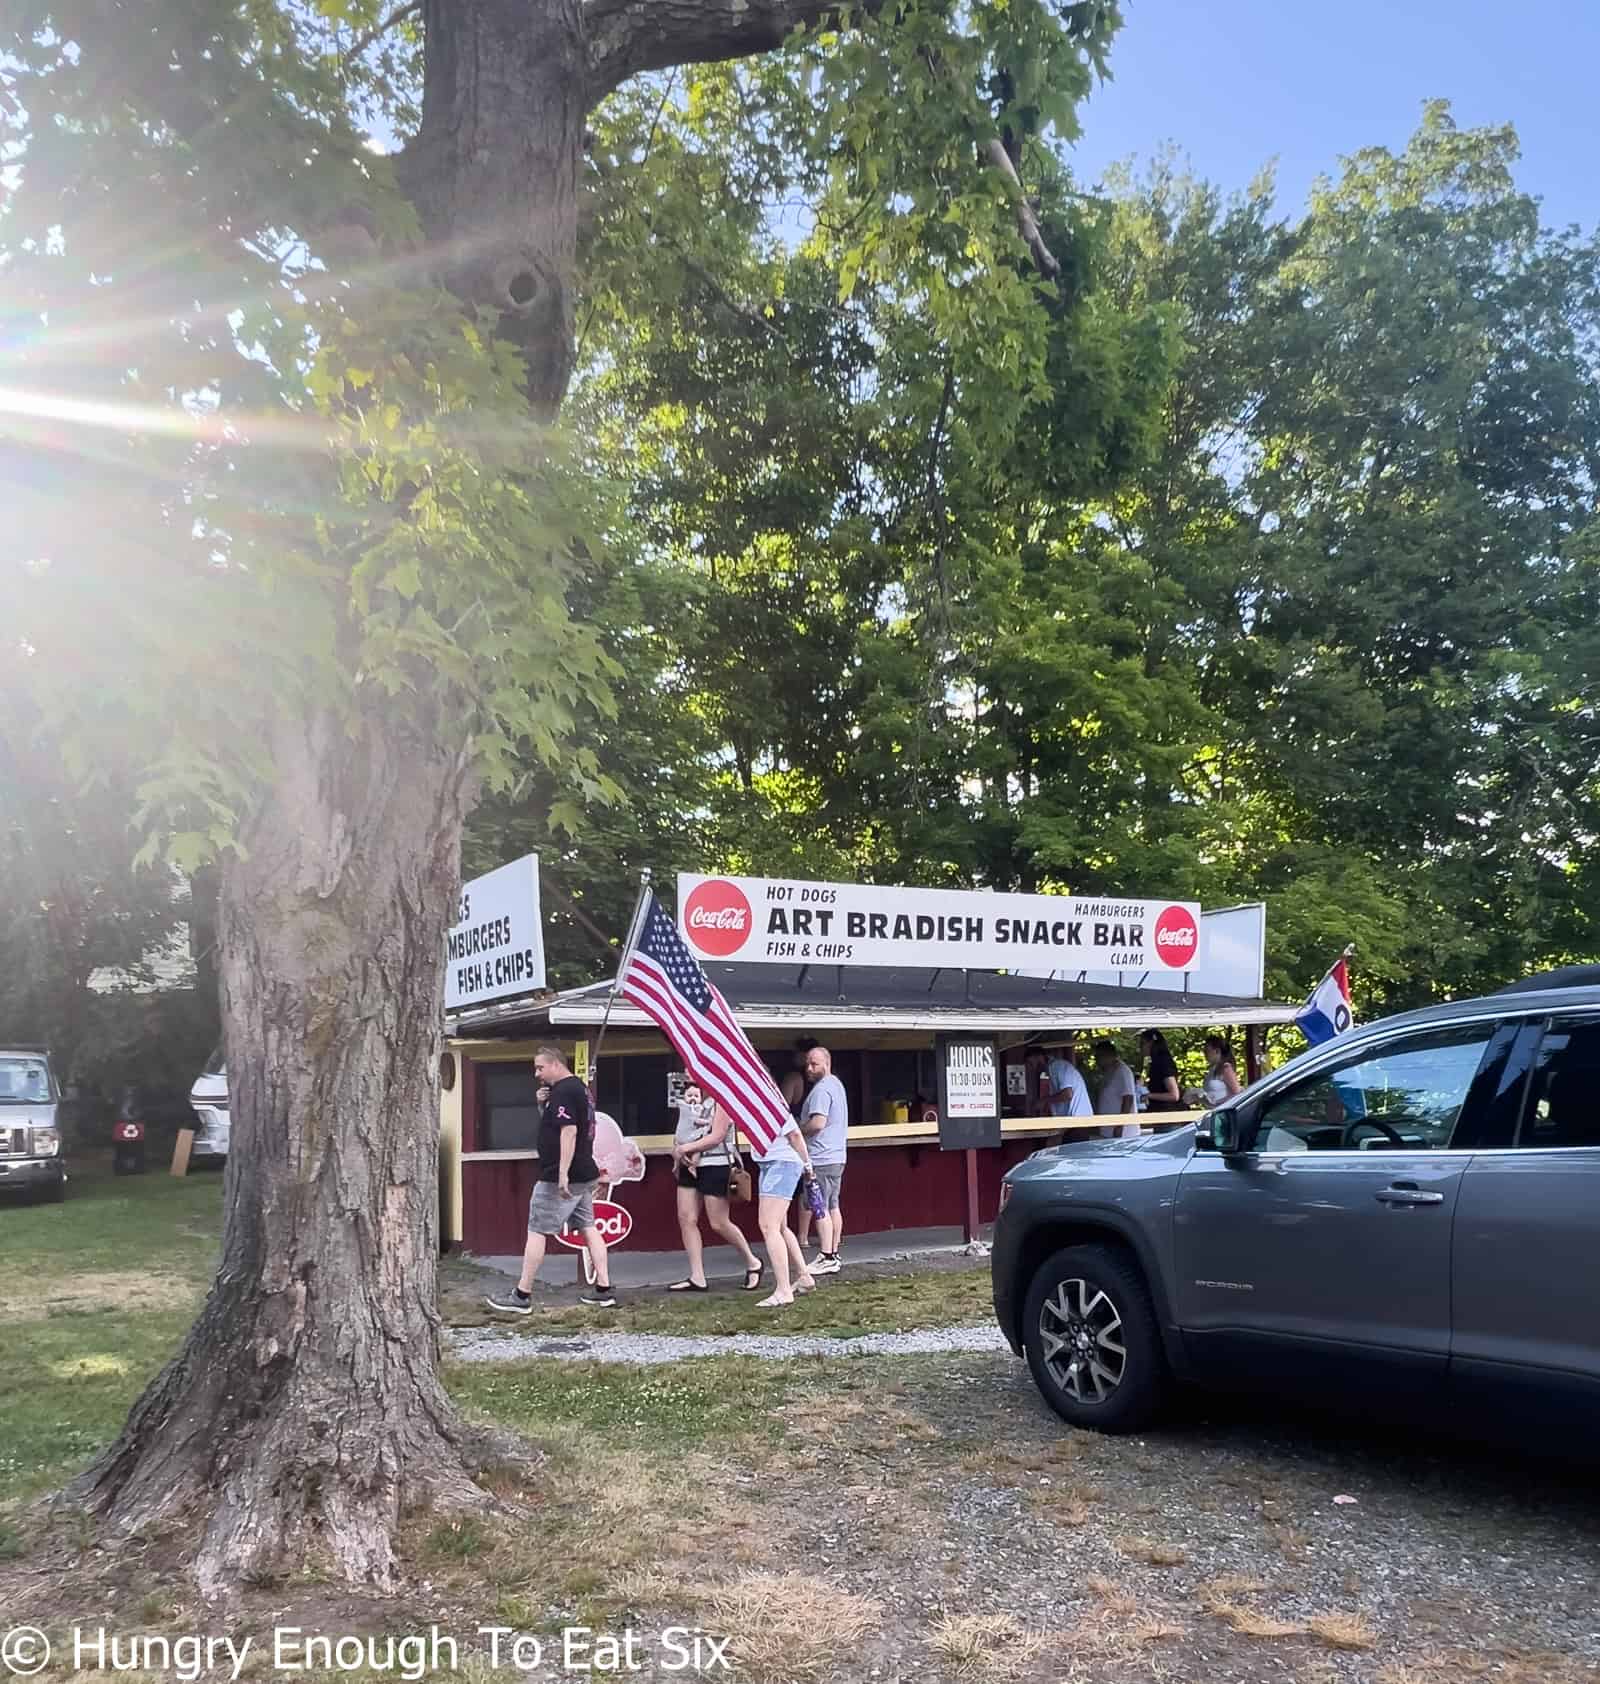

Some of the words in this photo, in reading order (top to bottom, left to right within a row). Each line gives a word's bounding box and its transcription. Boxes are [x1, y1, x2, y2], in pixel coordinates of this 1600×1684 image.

[766, 885, 794, 901] HOT
[800, 888, 837, 904] DOGS
[1075, 903, 1145, 919] HAMBURGERS
[766, 907, 834, 937] ART
[847, 912, 984, 943] BRADISH
[994, 918, 1083, 946] SNACK
[1093, 923, 1144, 947] BAR
[448, 915, 511, 961] MBURGERS
[766, 941, 796, 957] FISH
[801, 943, 811, 957] &
[815, 943, 853, 959] CHIPS
[1110, 952, 1144, 966] CLAMS
[457, 963, 482, 995] FISH
[485, 960, 494, 988] &
[495, 949, 534, 986] CHIPS
[950, 1046, 992, 1068] HOURS
